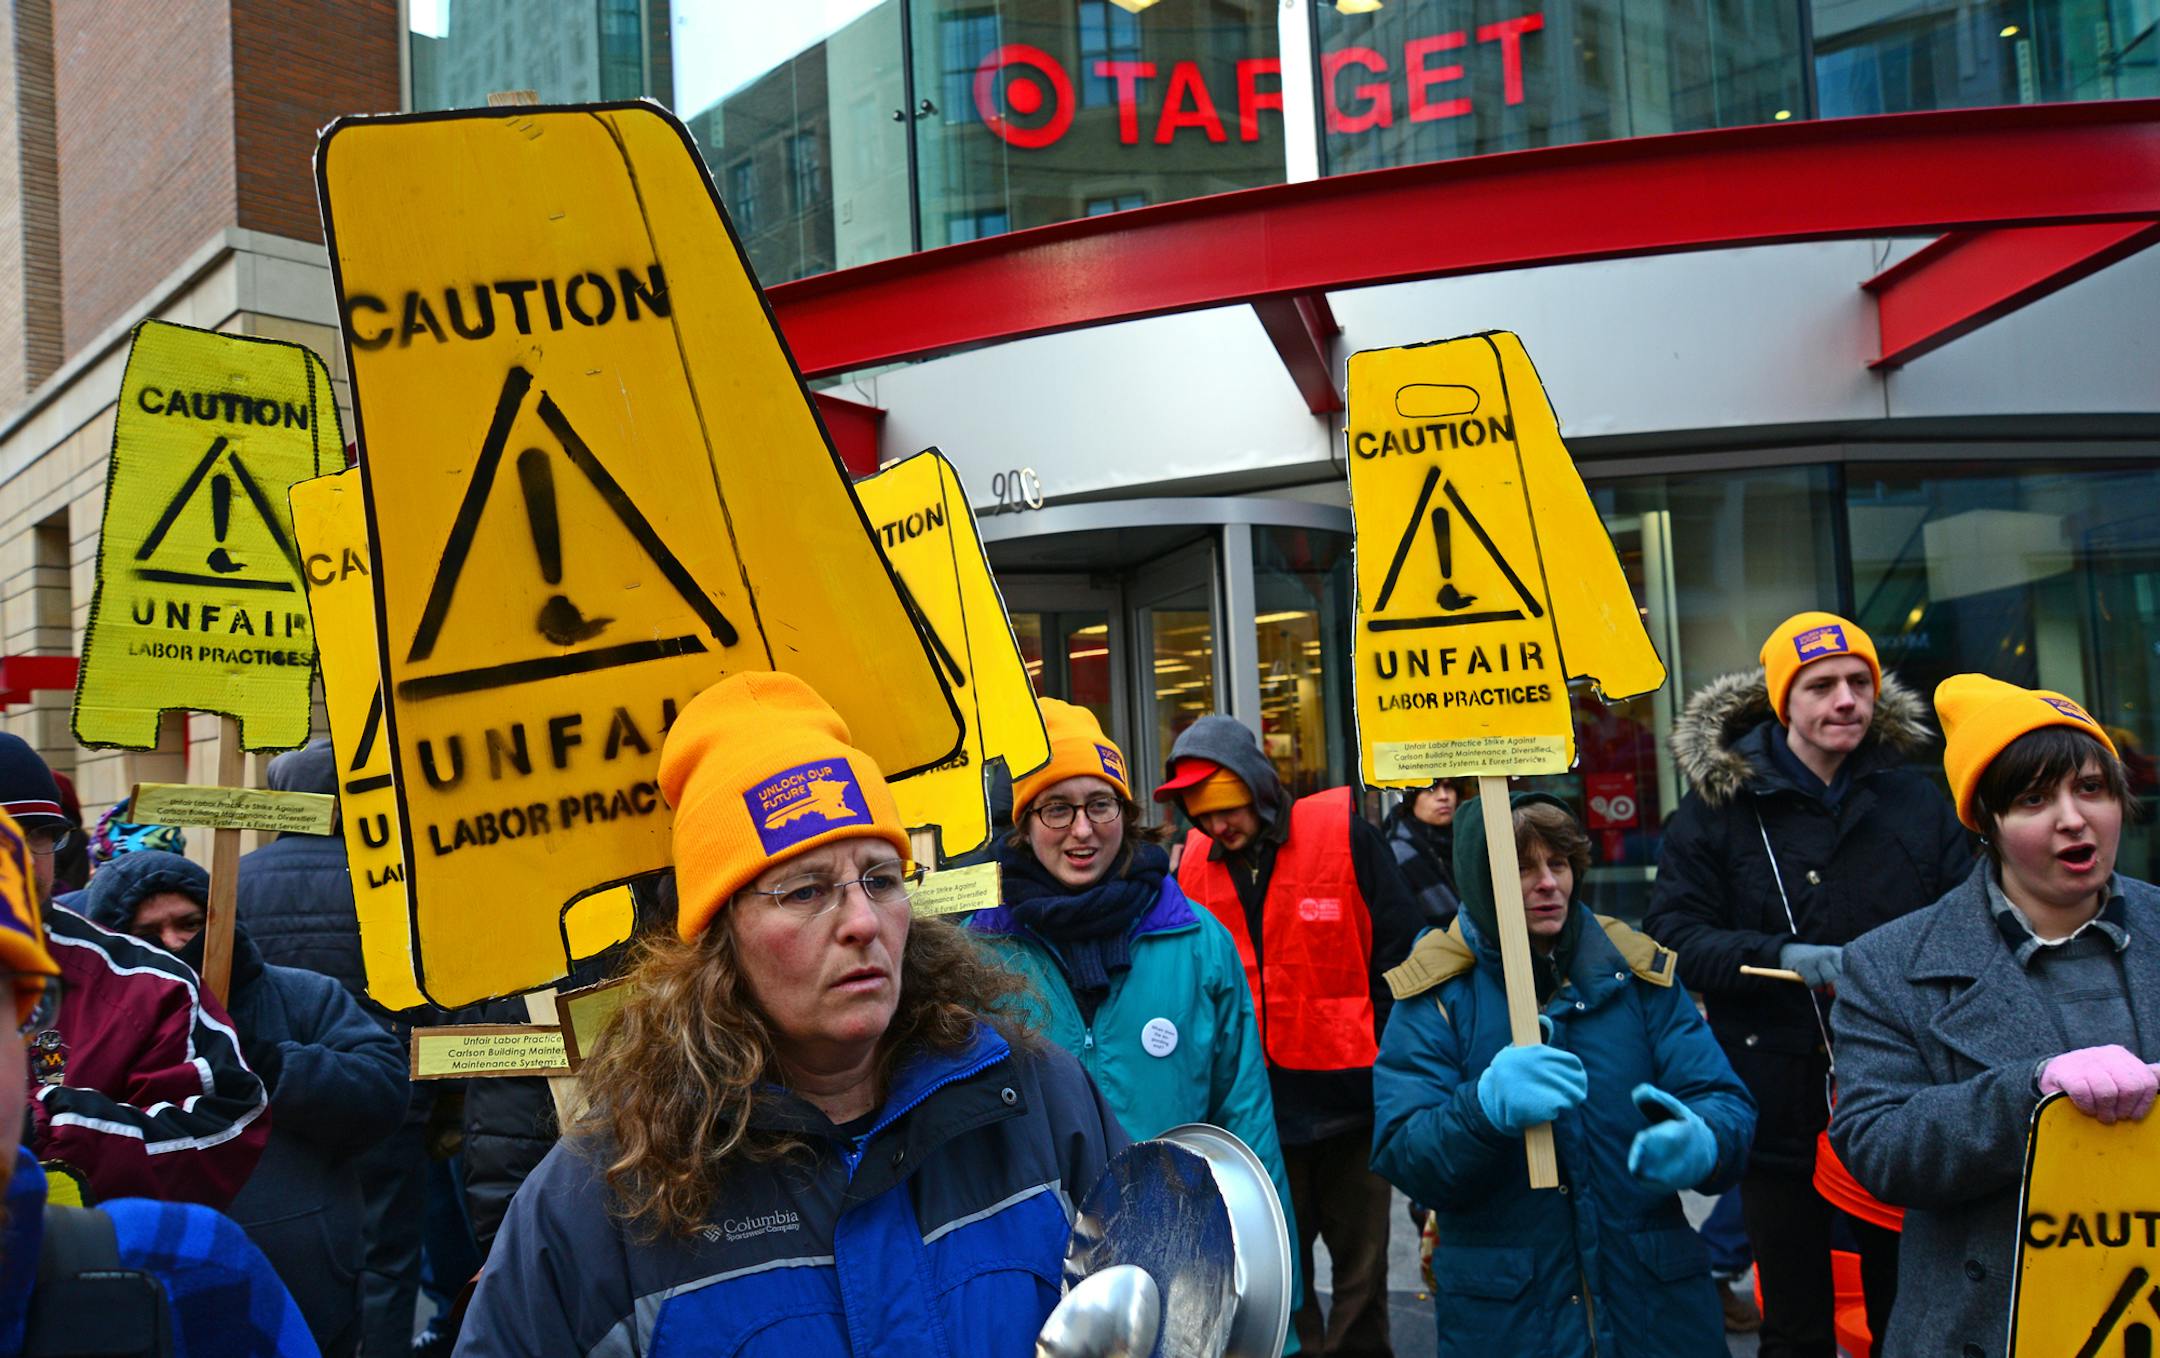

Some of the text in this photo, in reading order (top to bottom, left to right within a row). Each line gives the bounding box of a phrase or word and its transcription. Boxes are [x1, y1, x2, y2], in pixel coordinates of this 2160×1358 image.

[345, 263, 672, 351] CAUTION
[138, 386, 308, 430] CAUTION
[1355, 414, 1515, 459] CAUTION
[992, 467, 1043, 516] 900
[131, 598, 307, 638] UNFAIR
[128, 641, 315, 668] LABOR PRACTICES
[1374, 641, 1545, 680] UNFAIR
[1378, 684, 1552, 712] LABOR PRACTICES
[1394, 753, 1423, 761] Carlson
[1425, 751, 1454, 761] Building
[1404, 736, 1536, 751] Unfair Labor Practice Strike Against
[1399, 761, 1447, 770] Maintenance
[1449, 758, 1479, 768] Systems
[1489, 757, 1513, 766] Eurest
[1514, 755, 1546, 764] Services
[758, 766, 833, 800] UNLOCK OUR
[763, 785, 807, 811] FUTURE
[428, 801, 551, 857] LABOR
[448, 1049, 486, 1058] Carlson
[488, 1048, 526, 1058] Building
[463, 1035, 563, 1046] Unfair Labor Practice
[452, 1058, 567, 1069] Maintenance Systems &
[723, 1210, 799, 1234] Columbia
[725, 1223, 800, 1242] Sportswear Company
